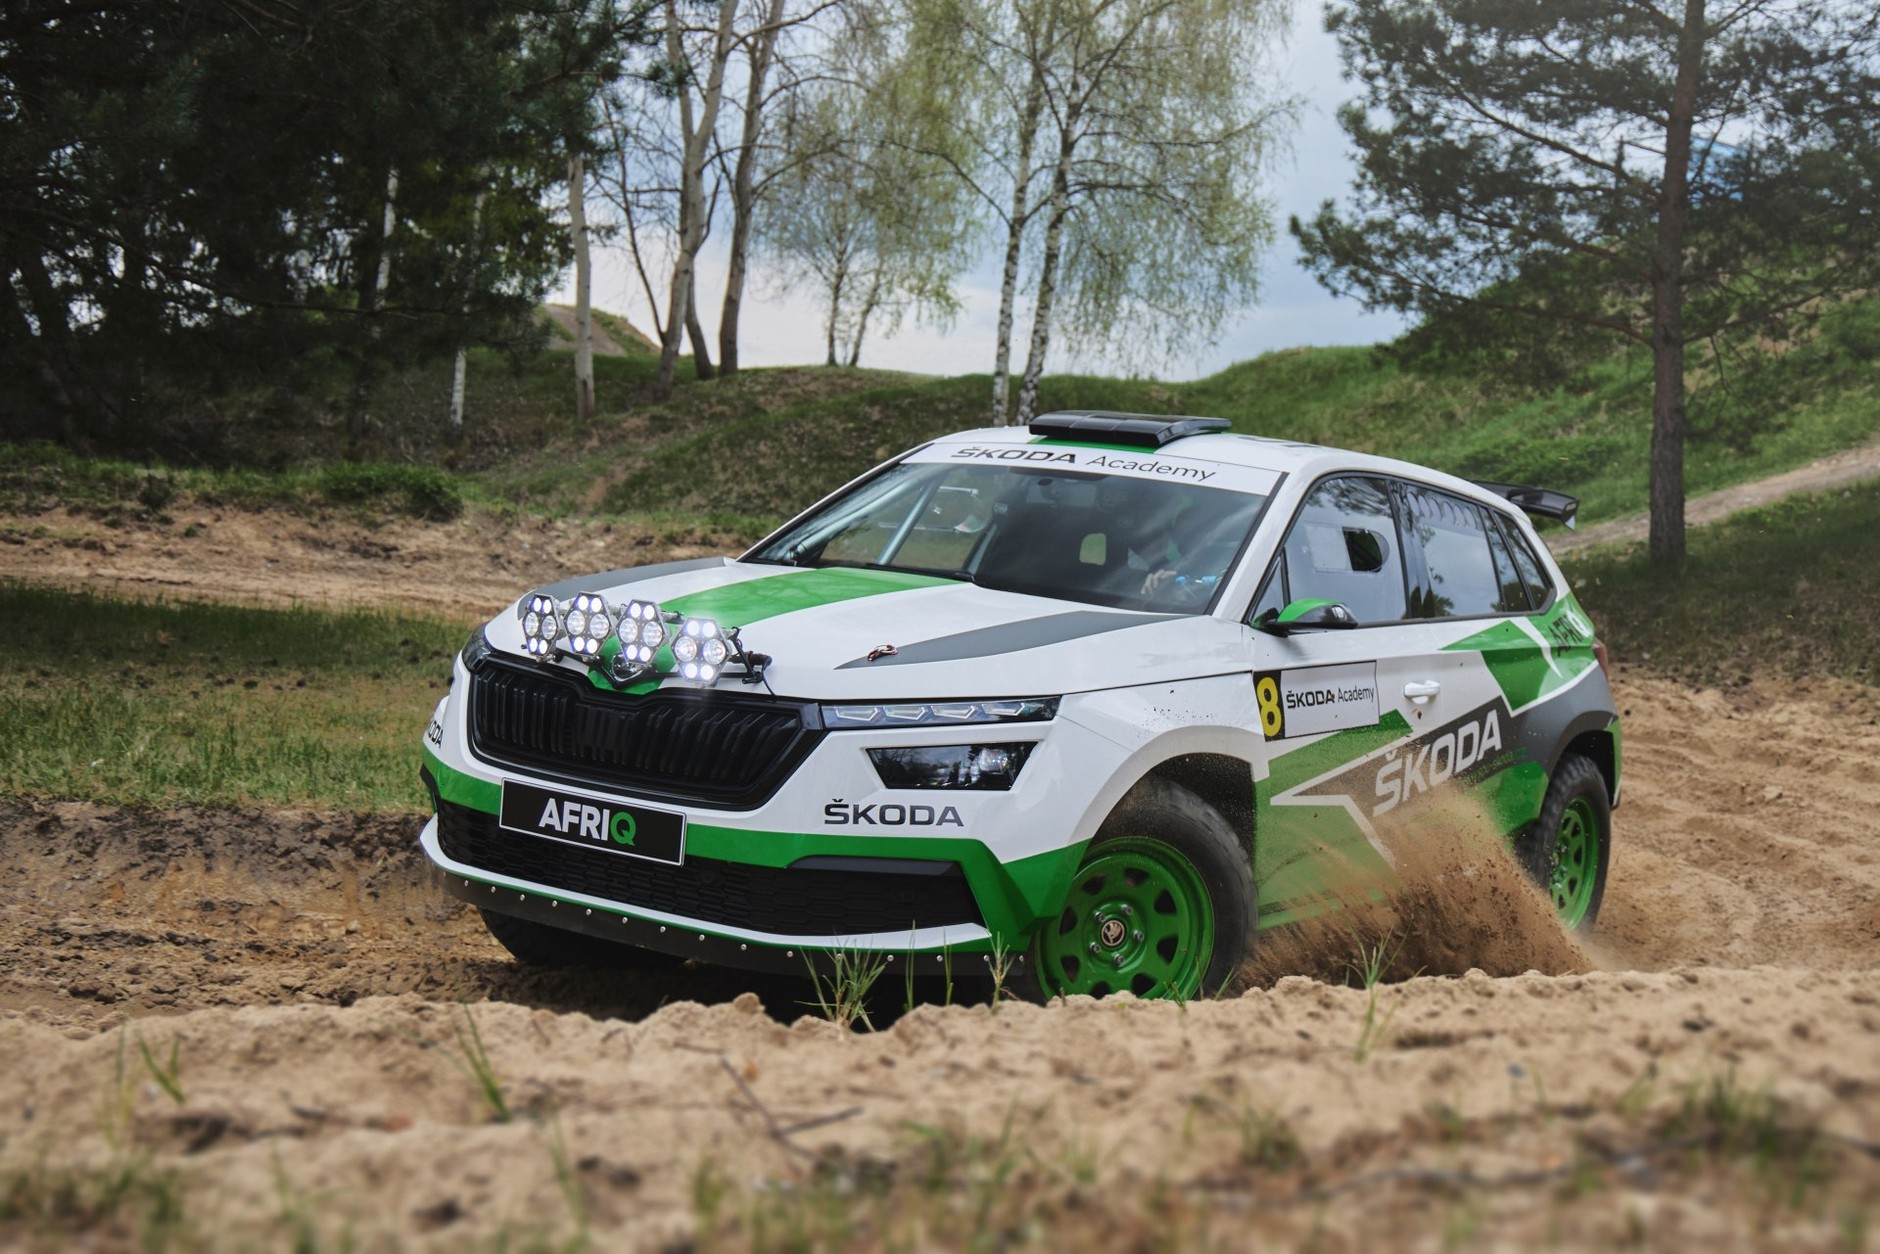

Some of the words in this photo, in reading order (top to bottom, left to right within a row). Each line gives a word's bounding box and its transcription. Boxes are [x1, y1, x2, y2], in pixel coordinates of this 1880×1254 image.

[951, 446, 1075, 464] ŠKODA
[1086, 456, 1216, 482] Academy
[1257, 677, 1282, 736] 8
[1286, 690, 1335, 709] ŠKODA
[1337, 685, 1374, 703] Academy
[1373, 709, 1502, 817] ŠKODA
[538, 797, 636, 846] AFRIQ
[824, 798, 964, 827] ŠKODA
